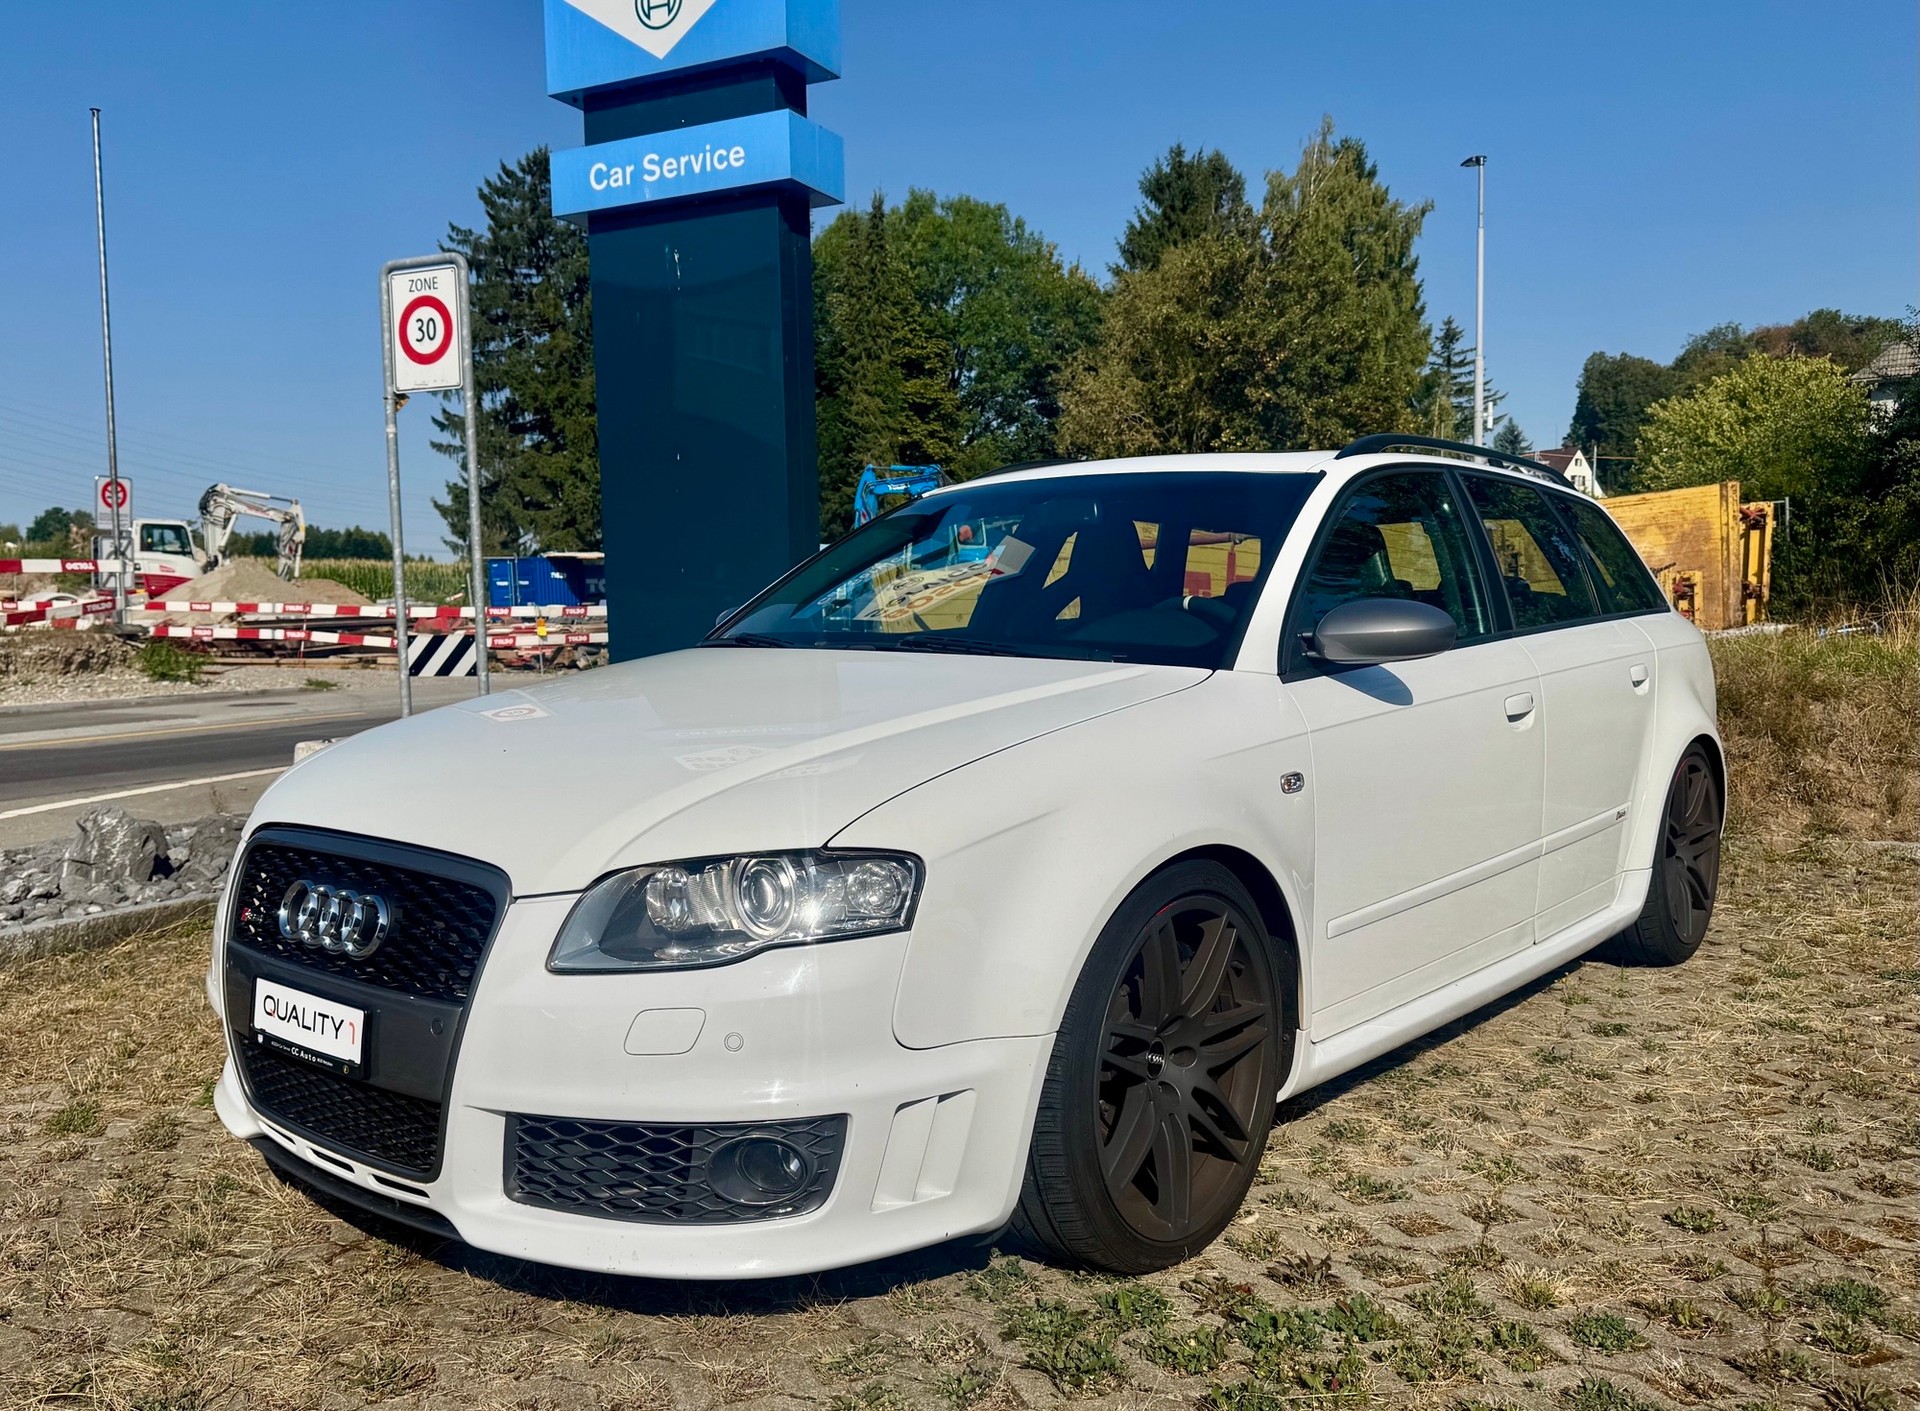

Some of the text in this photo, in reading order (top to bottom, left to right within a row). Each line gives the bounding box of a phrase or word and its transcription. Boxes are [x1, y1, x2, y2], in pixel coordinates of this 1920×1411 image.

[589, 144, 746, 191] Car Service
[408, 276, 439, 293] ZONE
[415, 317, 437, 343] 30
[489, 608, 510, 616] TOLDO
[564, 607, 585, 615] TOLDO
[300, 1050, 316, 1062] Auto
